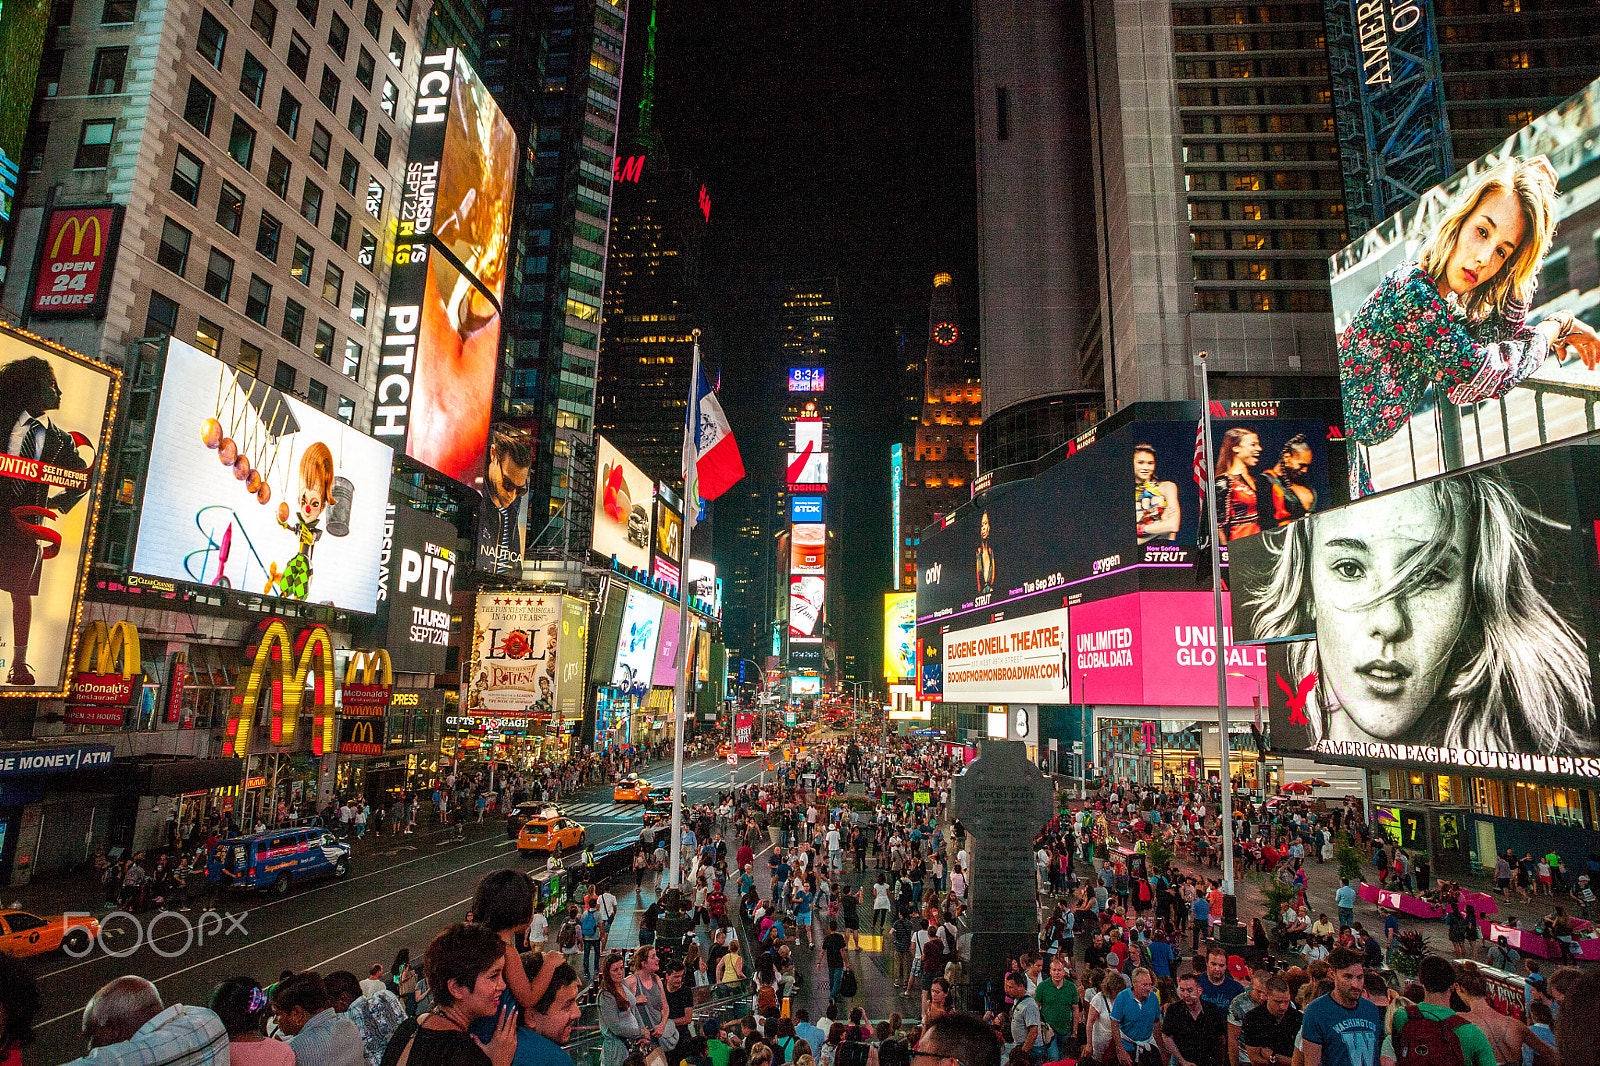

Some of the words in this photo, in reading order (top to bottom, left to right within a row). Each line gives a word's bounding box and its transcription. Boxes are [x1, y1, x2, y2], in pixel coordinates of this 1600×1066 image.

[404, 161, 423, 201] SEPT
[51, 261, 96, 273] OPEN
[52, 274, 88, 292] 24
[39, 293, 95, 306] HOURS
[373, 304, 421, 436] PITCH
[793, 369, 820, 381] 8:34
[1230, 400, 1281, 408] MARRIOTT
[1231, 408, 1276, 417] MARQUIS
[800, 410, 819, 418] 2016
[40, 473, 82, 489] JANUARY
[42, 464, 56, 475] SEE
[56, 467, 64, 477] IT
[63, 469, 89, 482] BEFORE
[787, 484, 828, 493] TOSHIBA
[801, 505, 820, 513] TDK
[480, 544, 523, 563] NAUTICA
[1144, 552, 1188, 562] STRUT
[1092, 554, 1121, 575] oxygen
[925, 562, 942, 585] only
[1024, 580, 1035, 594] Tue
[1036, 577, 1047, 591] Sep
[947, 640, 977, 661] EUGENE
[977, 635, 1010, 656] ONEILL
[1010, 626, 1060, 652] THEATRE
[1076, 627, 1133, 653] UNLIMITED
[1077, 652, 1110, 670] GLOBAL
[1110, 649, 1134, 667] DATA
[947, 663, 1060, 684] BOOKOFMORMONBROADWAY.COM
[343, 689, 389, 699] McDonald's
[65, 711, 86, 720] OPEN
[96, 713, 121, 722] HOURS
[18, 753, 76, 770] MONEY
[82, 750, 112, 766] ATM
[1324, 740, 1399, 760] AMERICAN
[1405, 744, 1459, 765] EAGLE
[1463, 748, 1600, 778] OUTFITTERS
